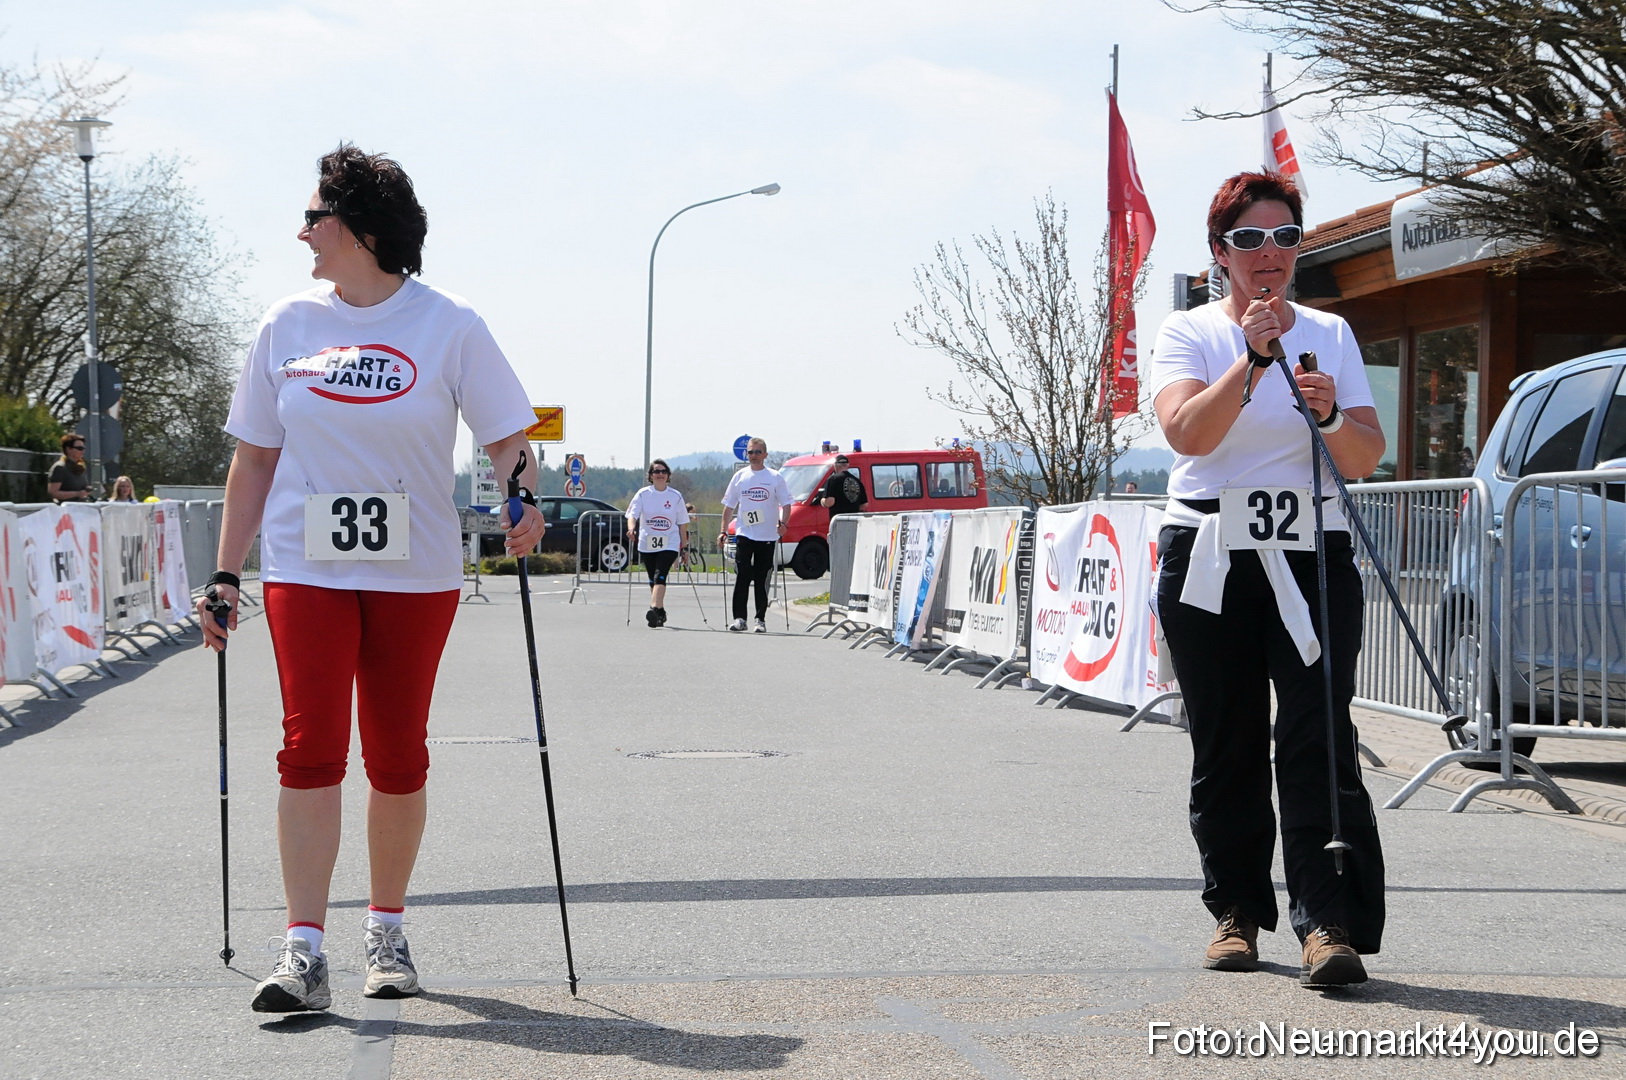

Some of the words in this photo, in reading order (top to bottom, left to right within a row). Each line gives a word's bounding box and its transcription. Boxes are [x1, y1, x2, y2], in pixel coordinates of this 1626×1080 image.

[392, 364, 401, 373] &
[747, 510, 759, 524] 31
[1248, 490, 1300, 541] 32
[331, 496, 388, 552] 33
[651, 536, 664, 549] 34
